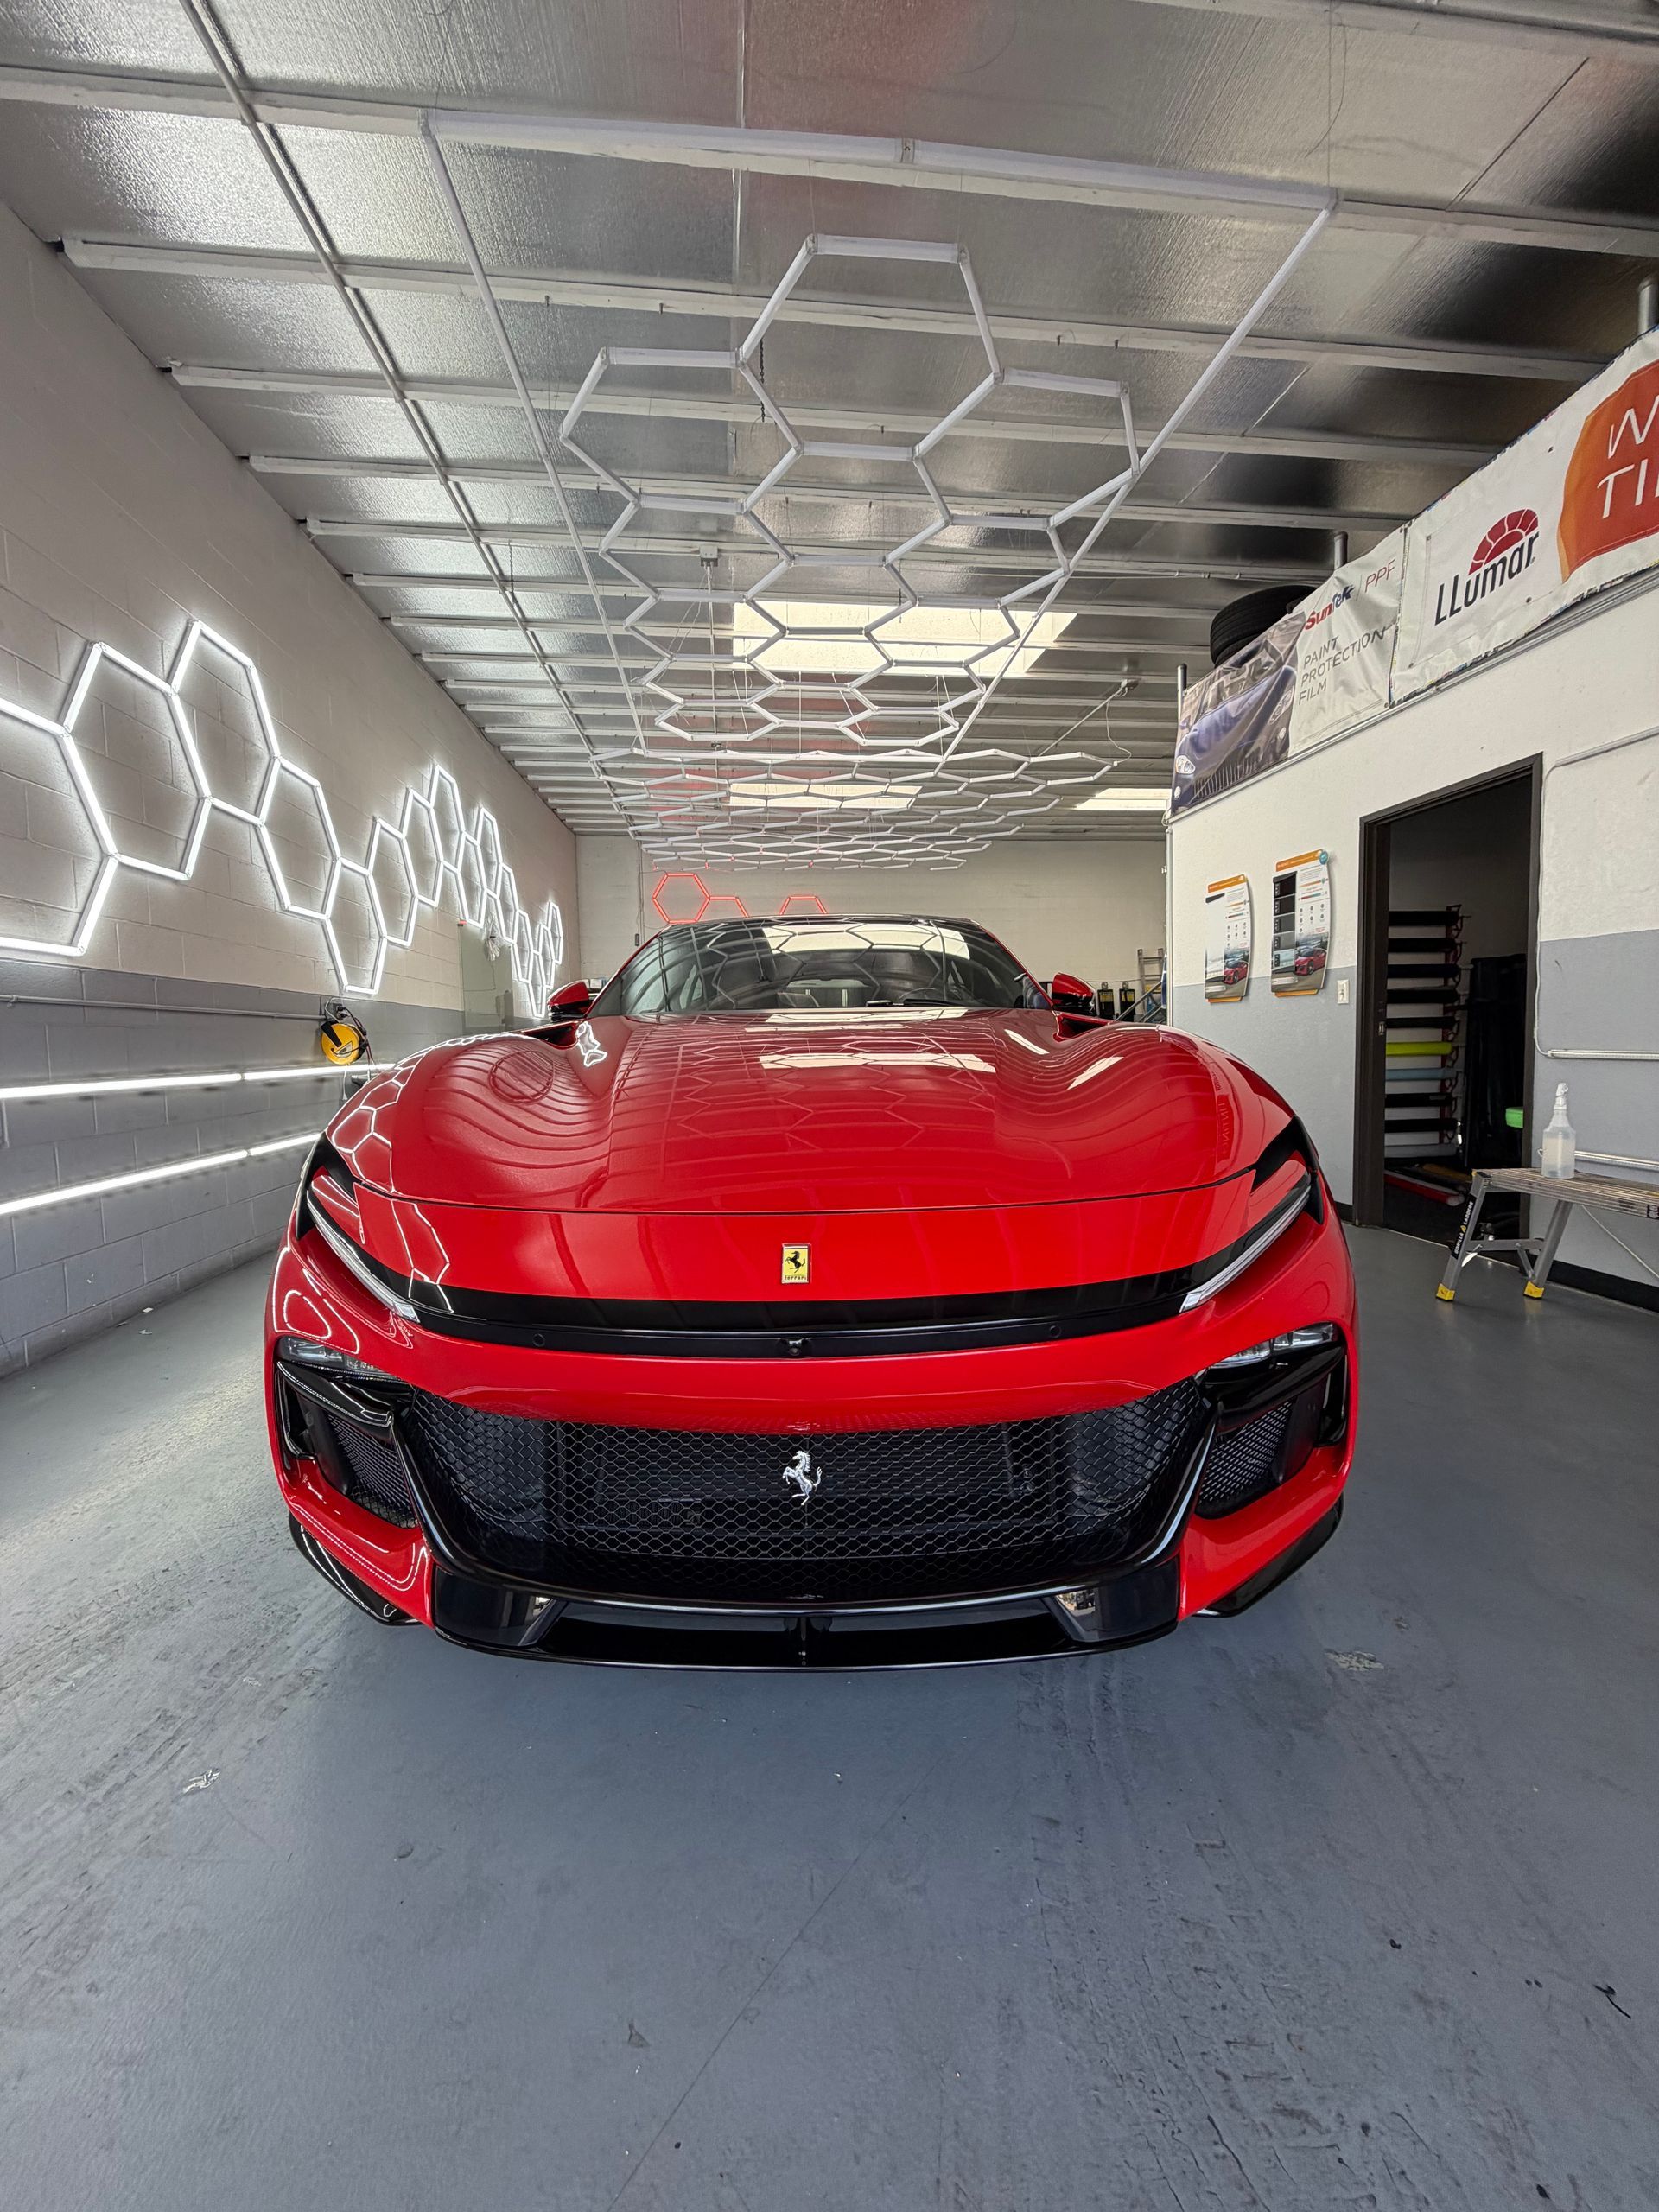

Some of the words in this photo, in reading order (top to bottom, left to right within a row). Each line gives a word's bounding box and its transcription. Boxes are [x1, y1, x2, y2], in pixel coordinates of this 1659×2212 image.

[1597, 458, 1659, 519] TI
[1305, 584, 1355, 631] SunTek
[1364, 558, 1396, 593] PPF
[1434, 531, 1540, 626] LLumar
[1300, 626, 1388, 688] PROTECTION
[1303, 635, 1339, 670] PAINT
[1298, 678, 1327, 706] FILM
[1453, 1232, 1465, 1255] GORILLA
[1463, 1200, 1474, 1225] LADDERS
